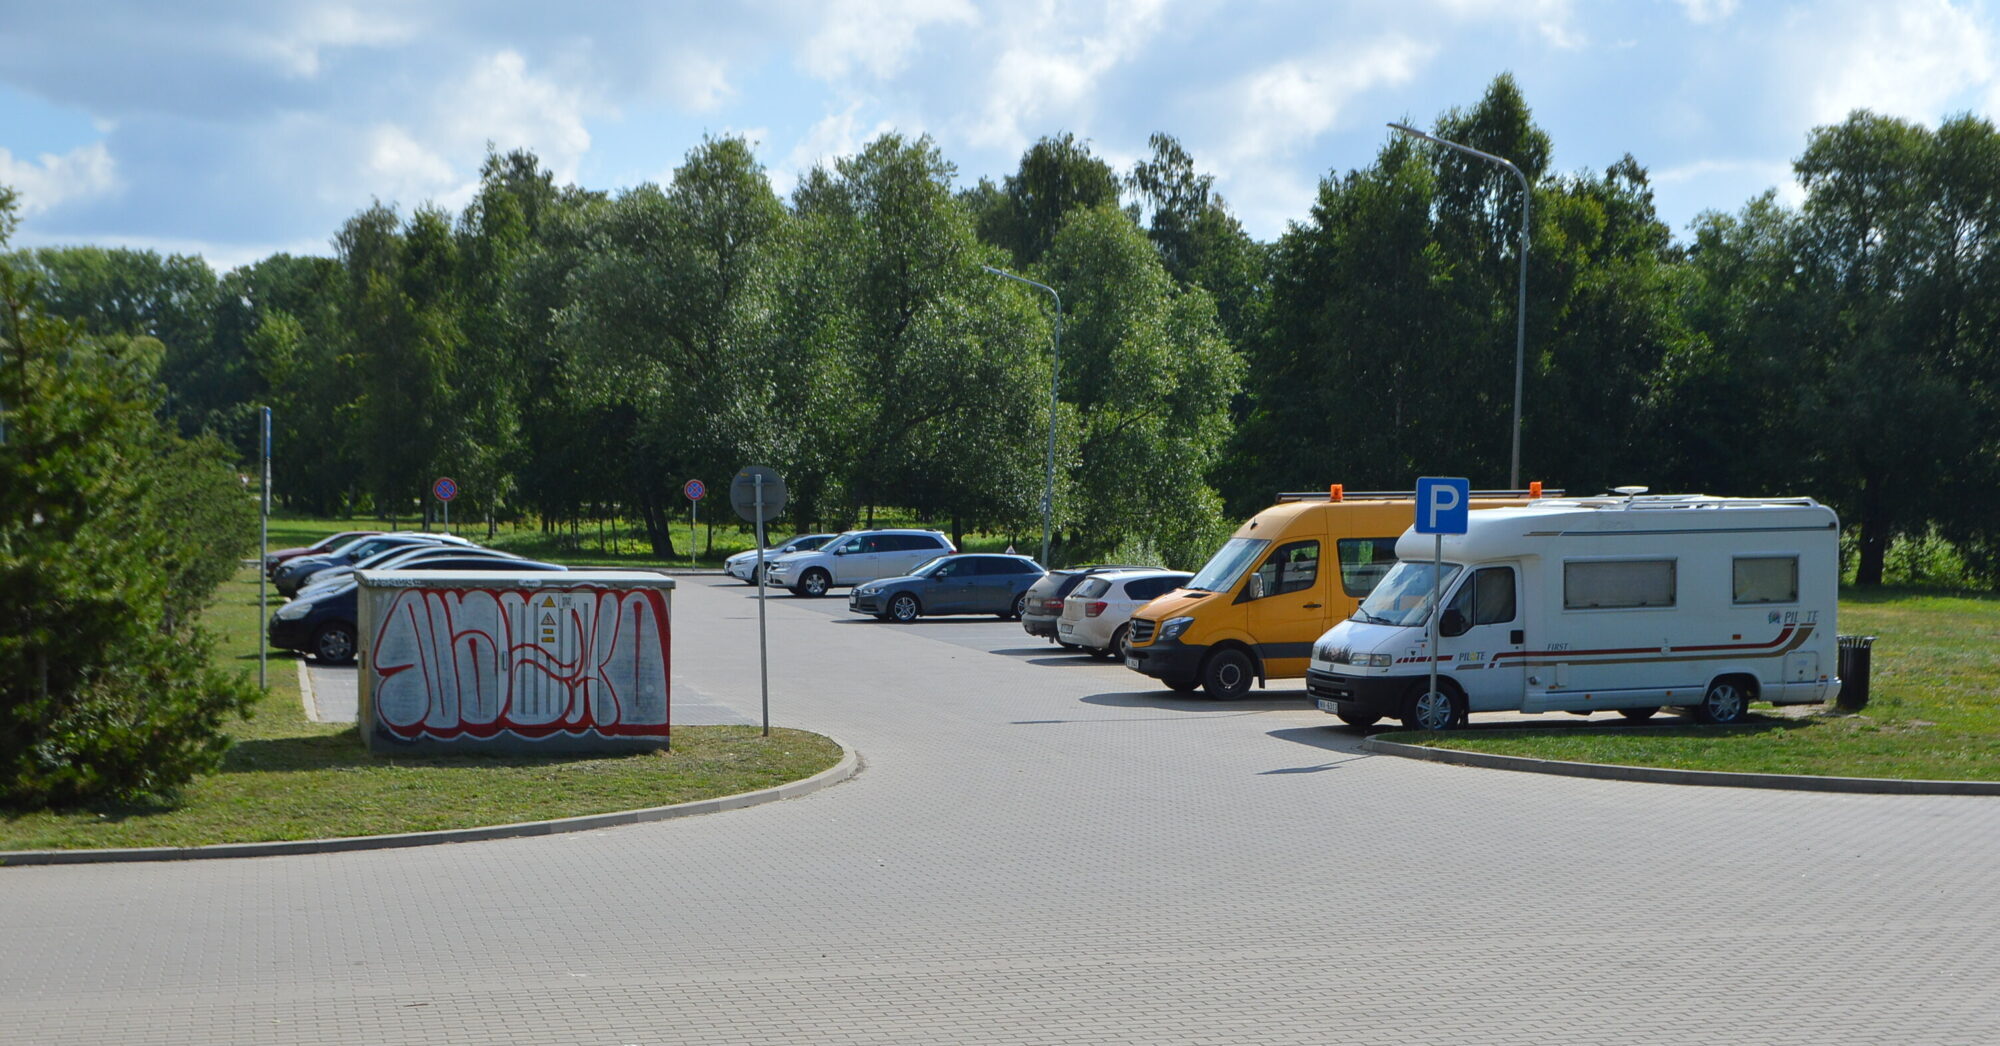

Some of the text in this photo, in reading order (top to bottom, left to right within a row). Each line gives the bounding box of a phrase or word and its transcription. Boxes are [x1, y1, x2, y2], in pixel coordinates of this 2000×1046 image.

[1430, 484, 1459, 528] P
[1784, 610, 1819, 624] PILTE
[1547, 642, 1568, 651] FIRST
